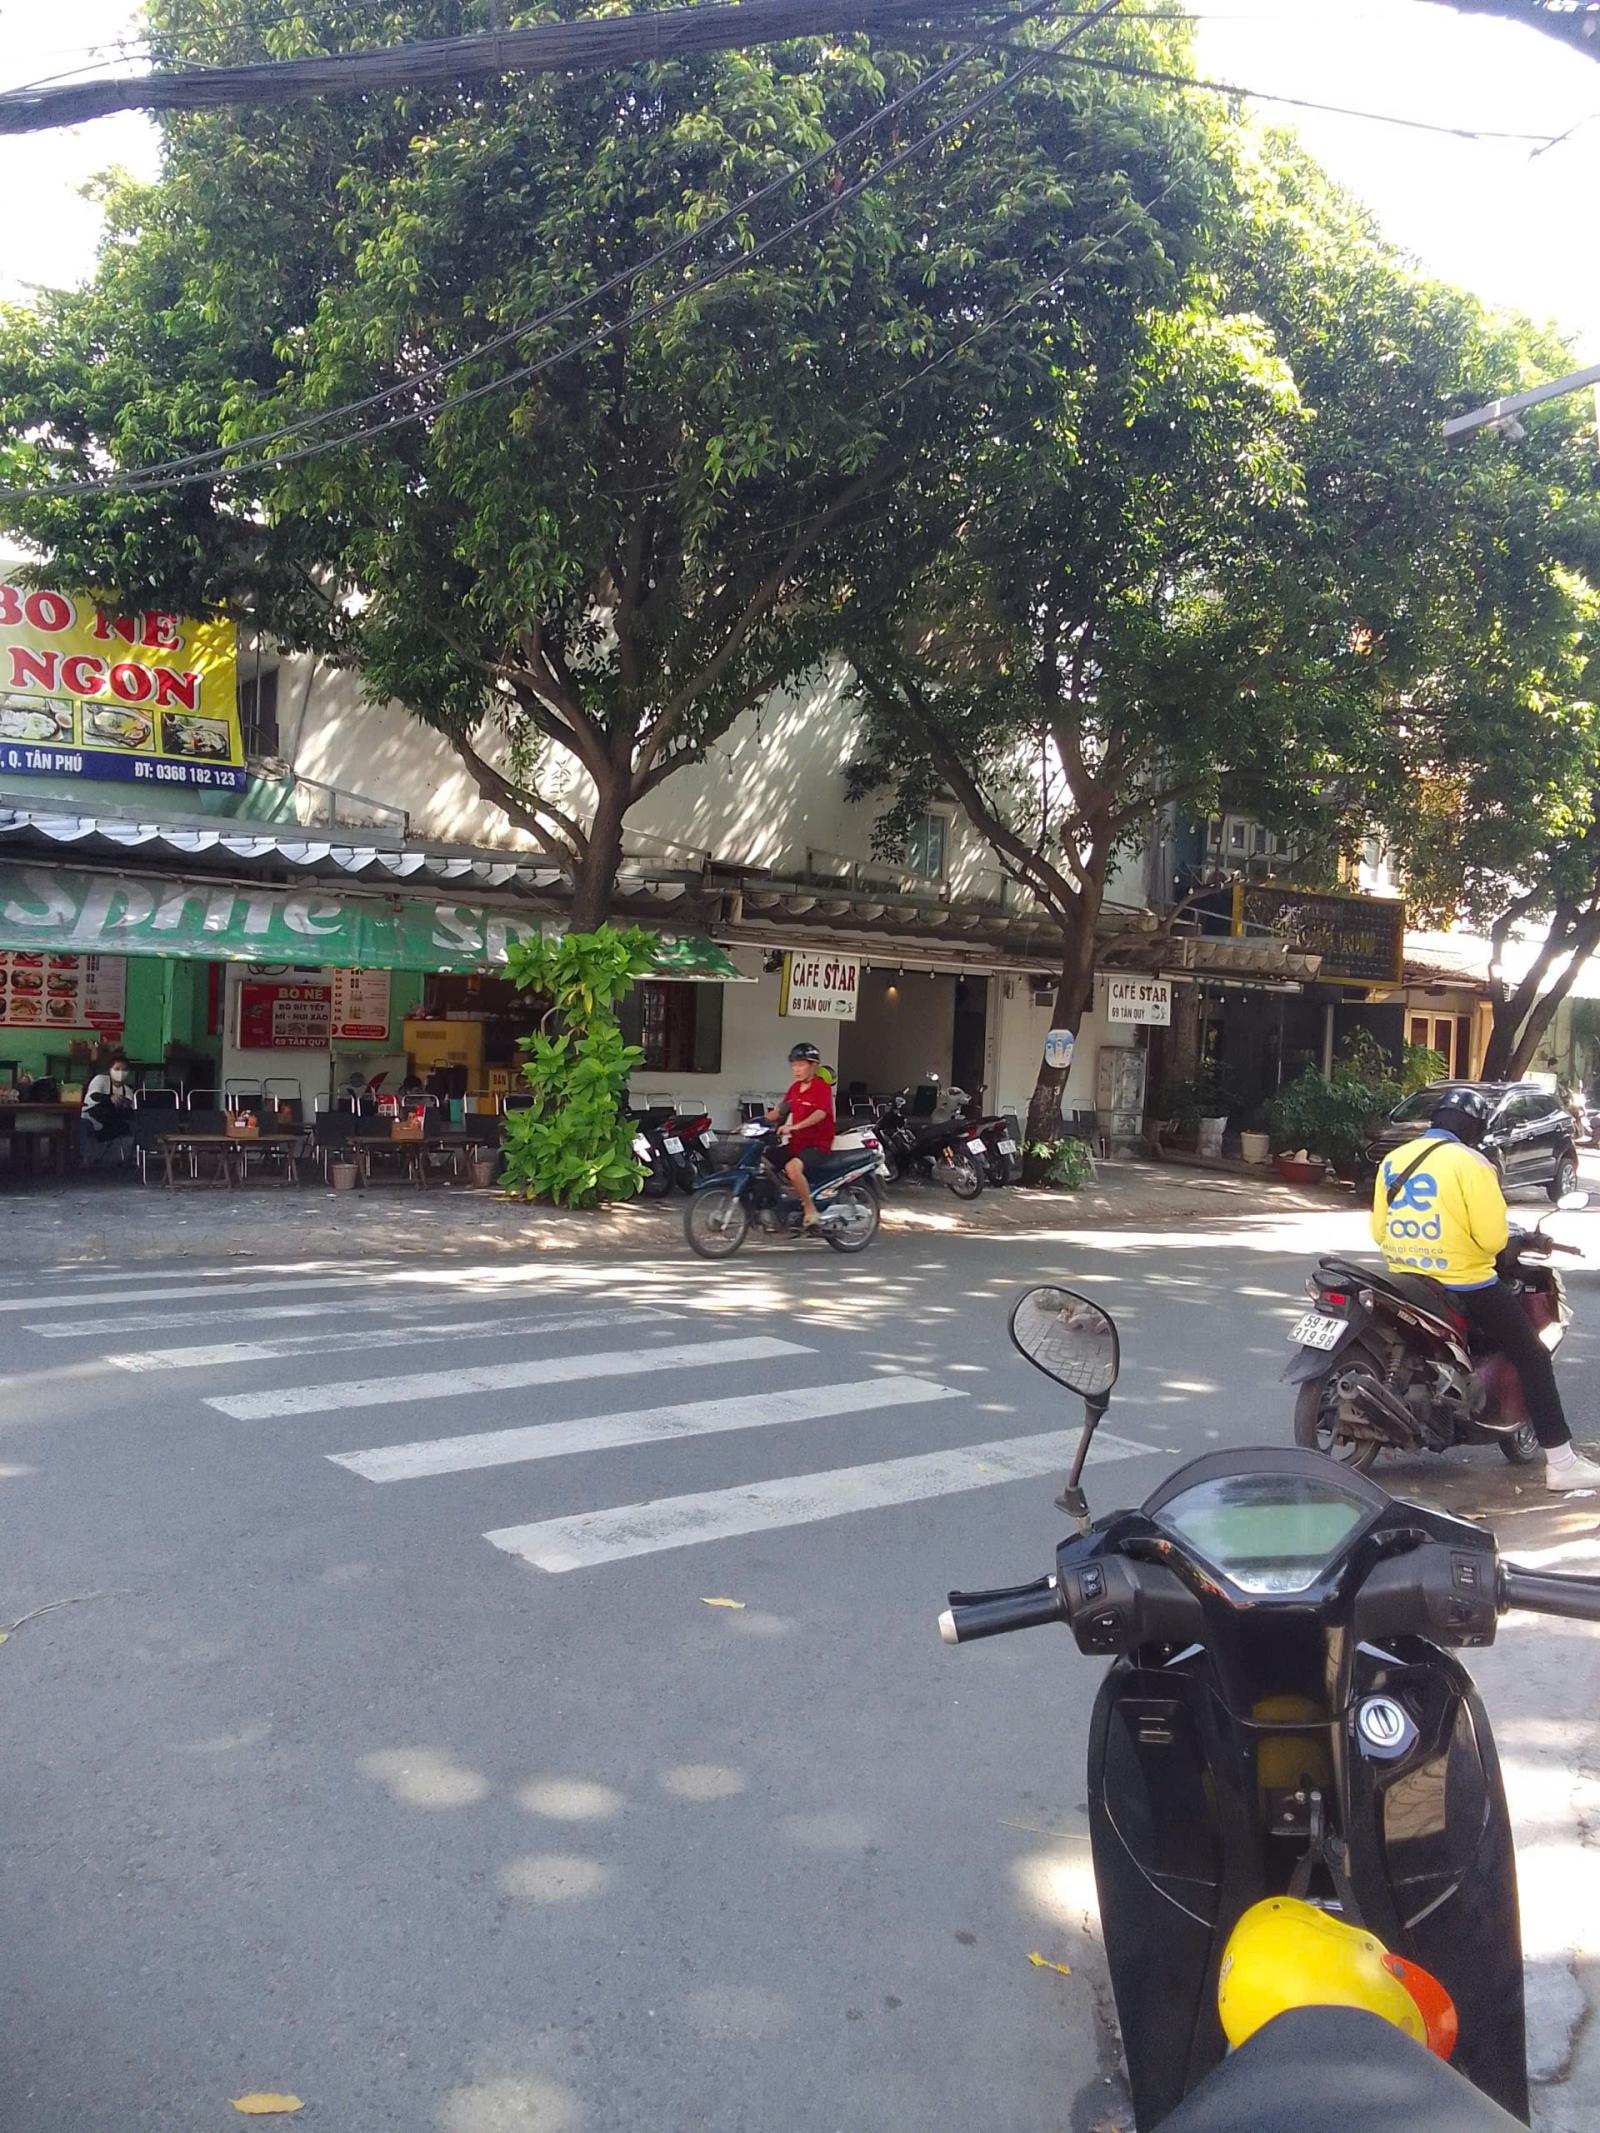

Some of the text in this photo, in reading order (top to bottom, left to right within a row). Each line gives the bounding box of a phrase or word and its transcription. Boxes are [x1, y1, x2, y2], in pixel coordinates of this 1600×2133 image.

[8, 645, 203, 711] NGON
[8, 750, 22, 768] Q.
[25, 749, 52, 770] TÂN
[55, 753, 83, 773] PHÚ
[134, 761, 154, 778] ĐT:
[156, 764, 187, 781] 0368
[190, 767, 212, 784] 182
[213, 771, 235, 786] 123
[3, 868, 344, 940] Sprite
[793, 956, 856, 992] CAFÉ STAR
[1112, 981, 1167, 1003] CAFÉ STAR
[792, 998, 802, 1010] 69
[803, 996, 817, 1011] TÂN
[1386, 1212, 1441, 1240] ood
